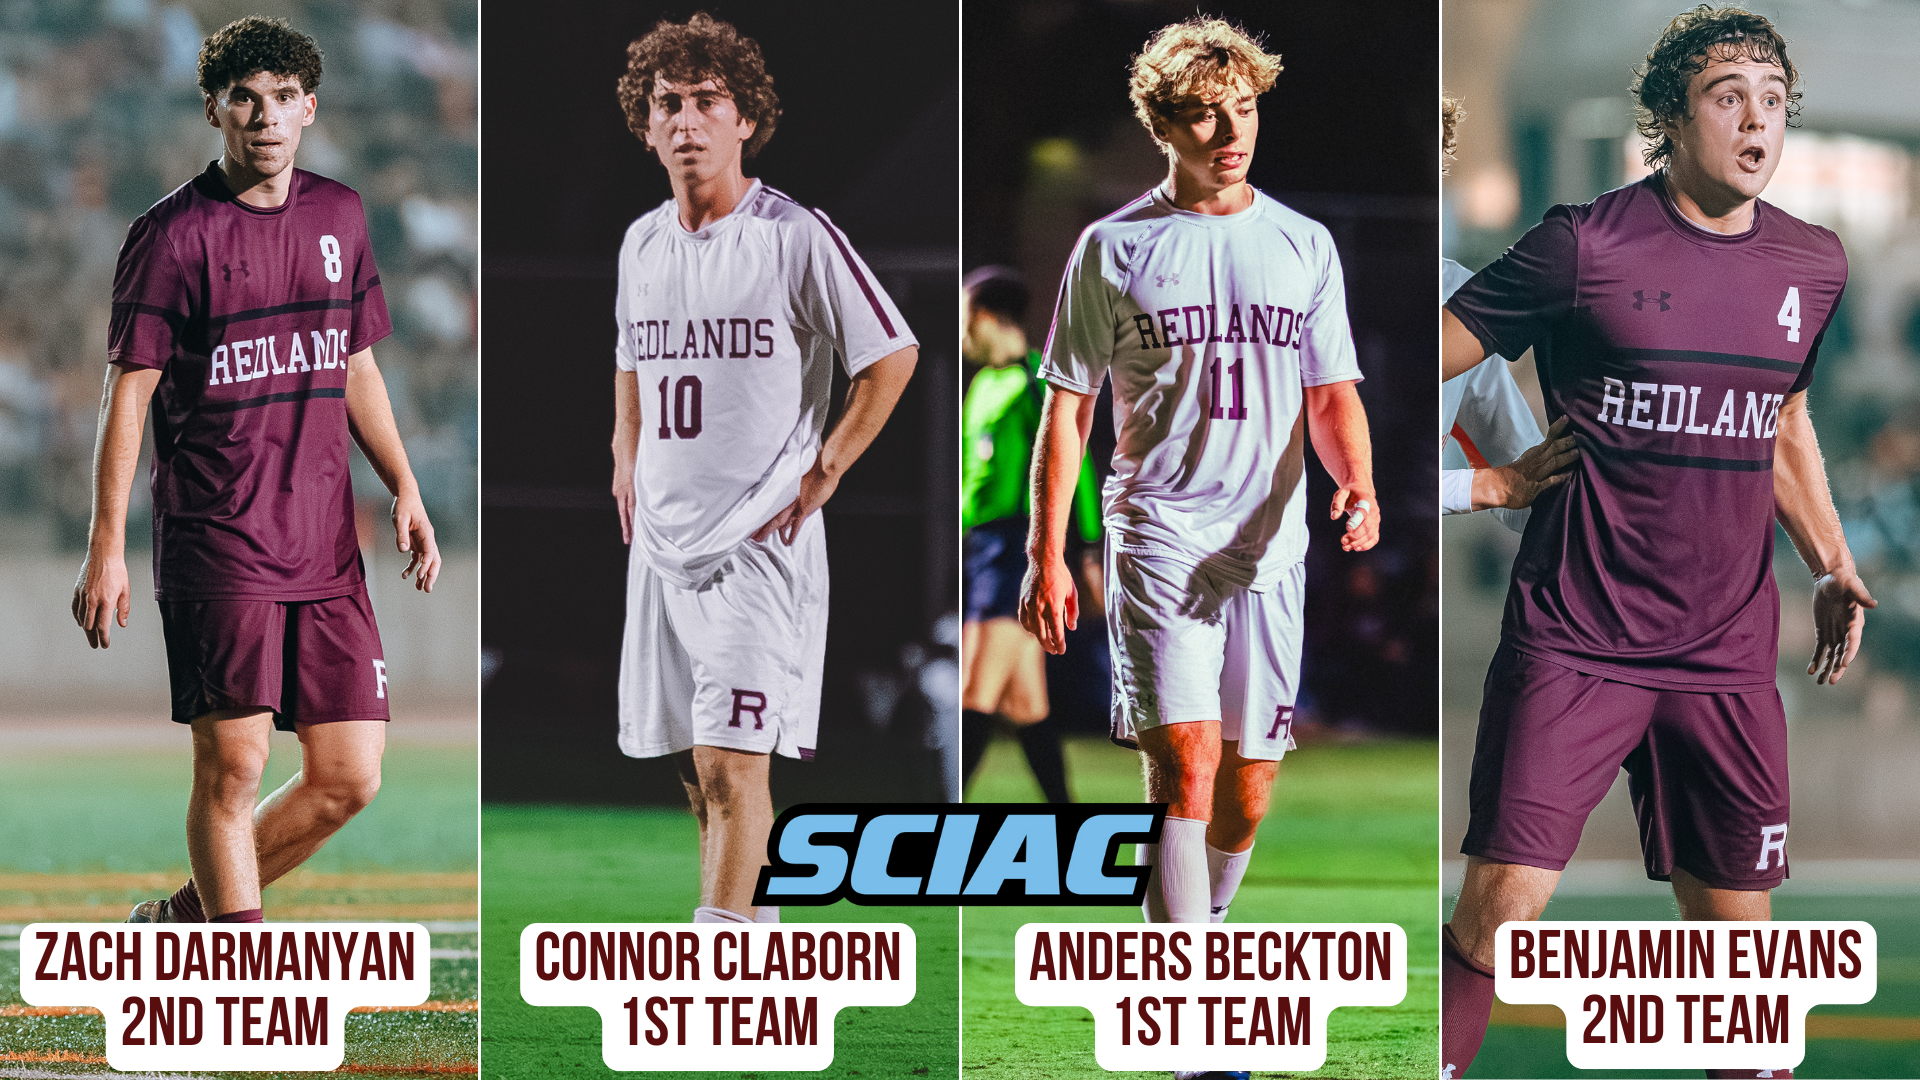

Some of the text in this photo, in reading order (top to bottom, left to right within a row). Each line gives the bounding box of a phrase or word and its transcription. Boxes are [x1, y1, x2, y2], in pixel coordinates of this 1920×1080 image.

[319, 235, 342, 283] 8
[1133, 304, 1304, 351] REDLANDS
[1777, 286, 1801, 343] 4
[209, 328, 348, 386] REDLANDS
[630, 318, 774, 361] EDLANDS
[658, 375, 702, 440] 10
[1209, 357, 1248, 420] 11
[1597, 376, 1784, 439] REDLAND
[728, 688, 767, 730] R
[1266, 705, 1293, 740] R
[1755, 822, 1788, 870] R
